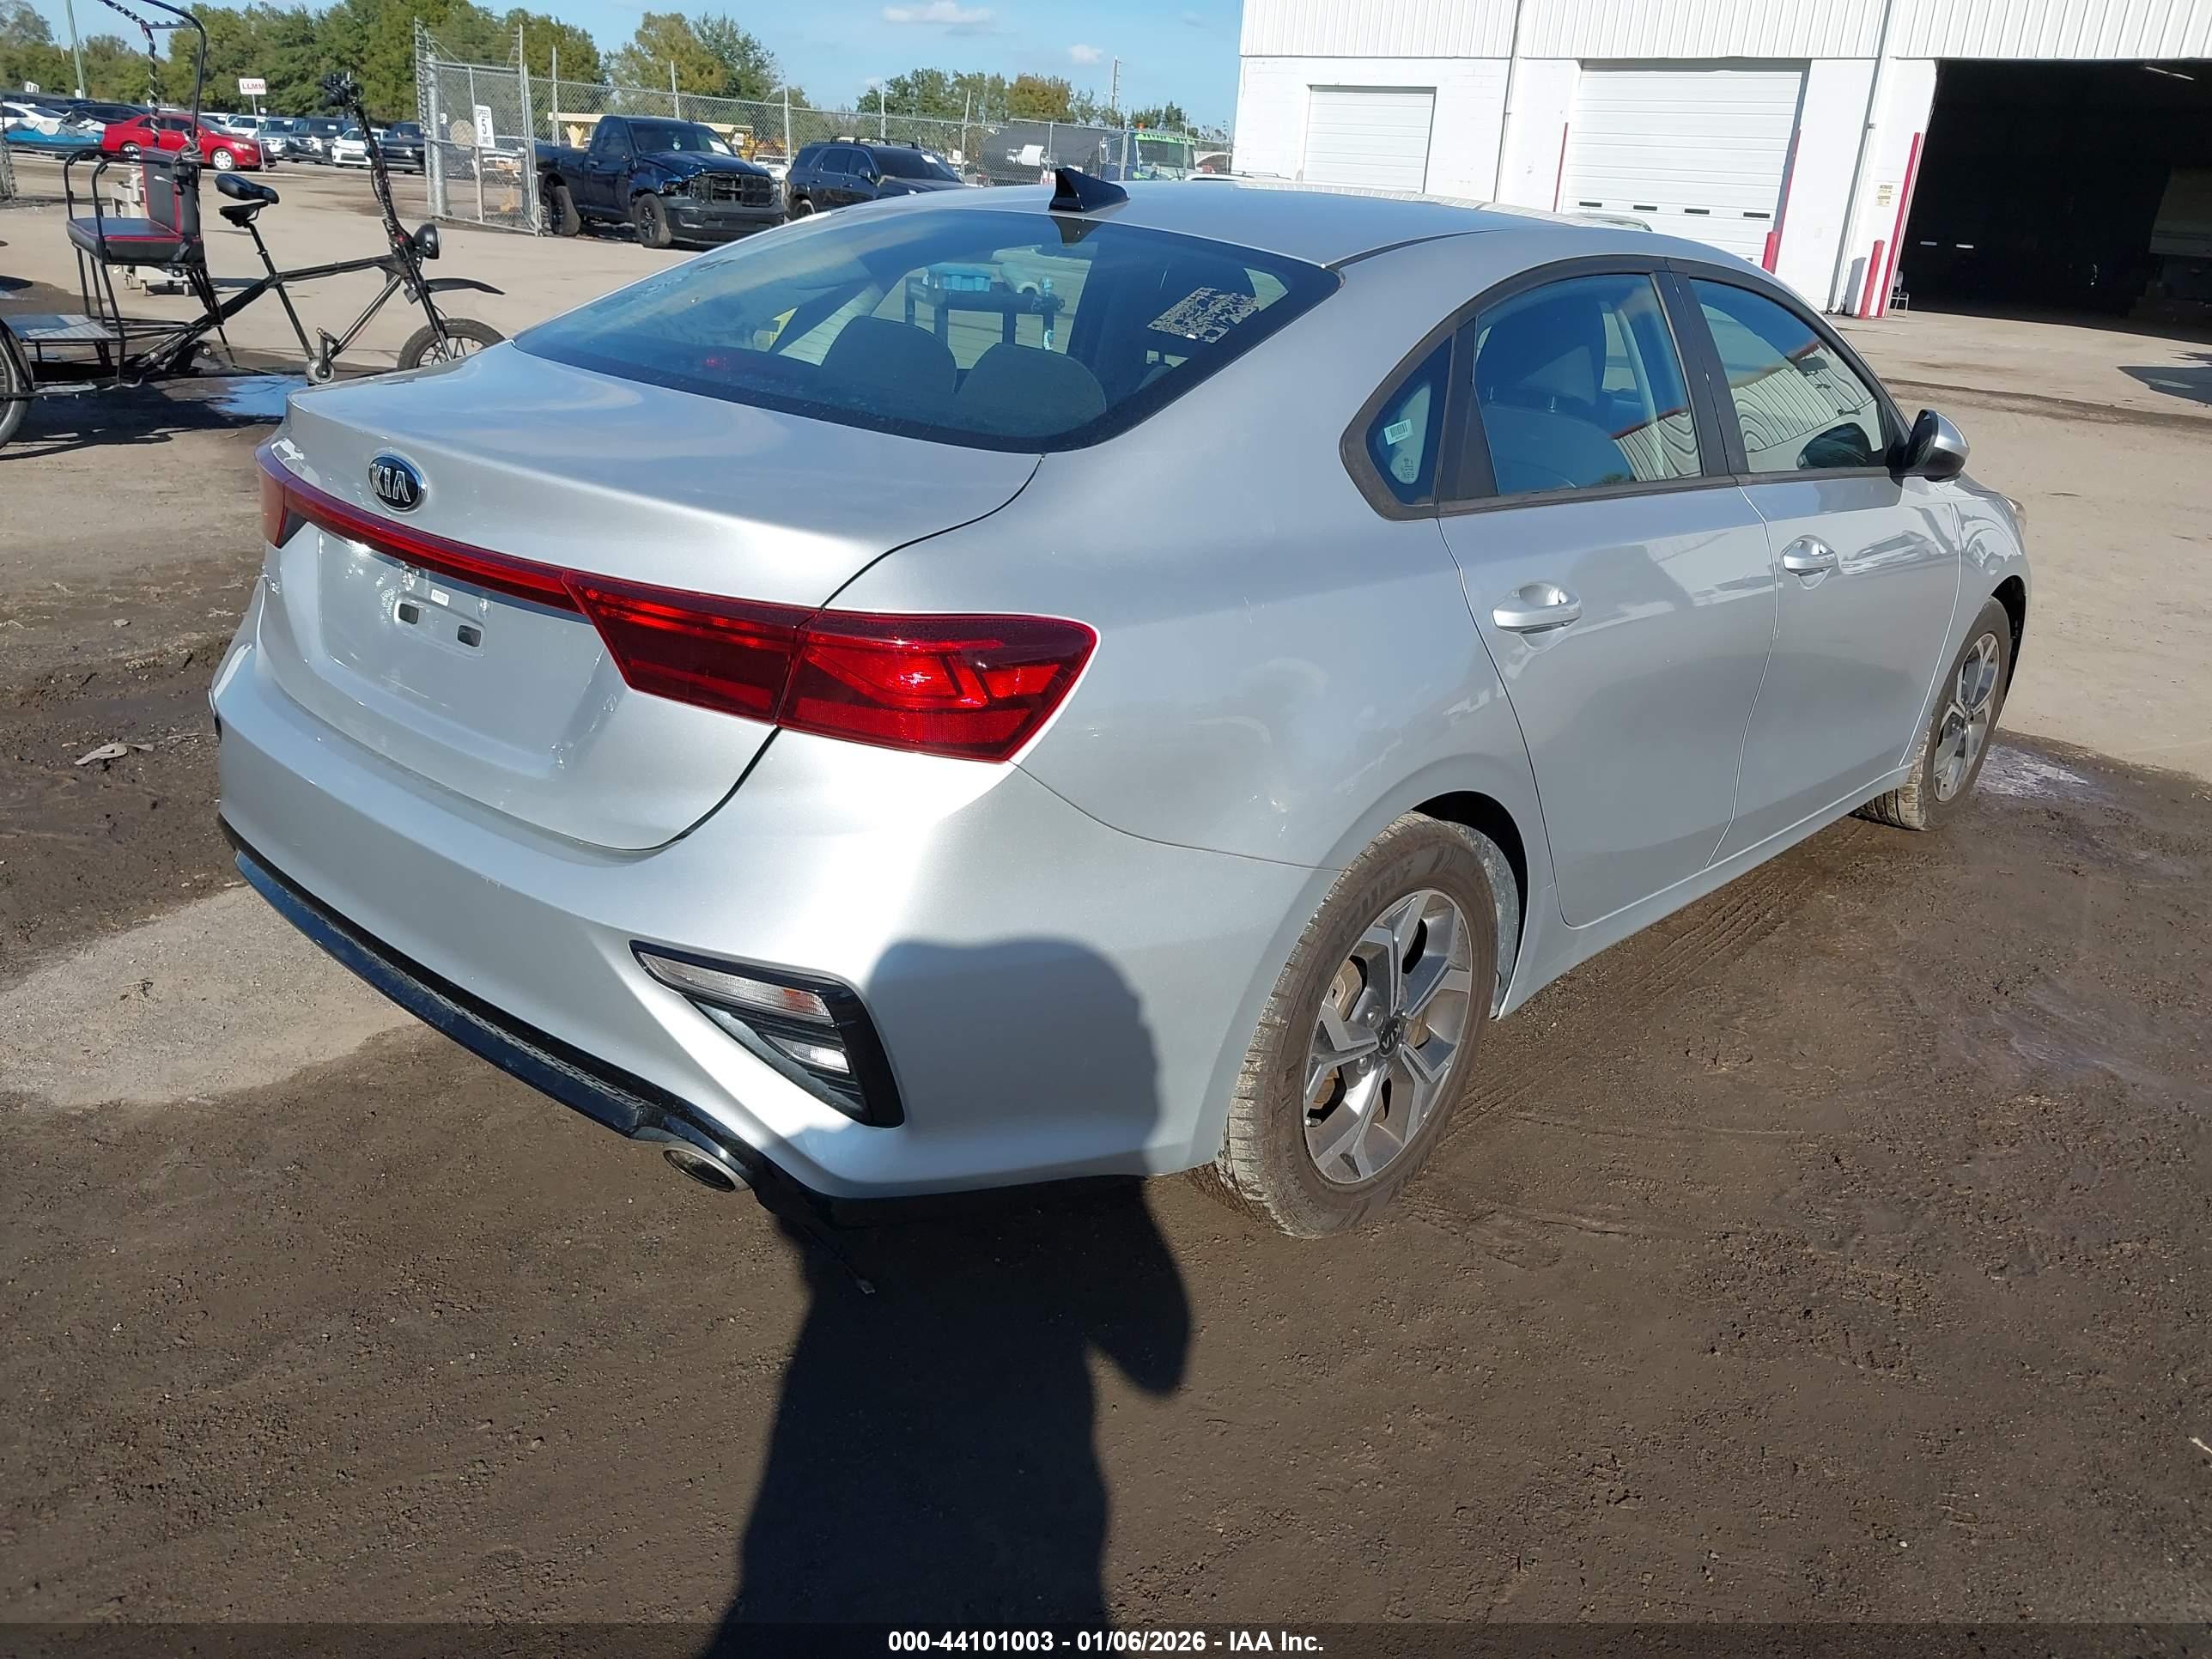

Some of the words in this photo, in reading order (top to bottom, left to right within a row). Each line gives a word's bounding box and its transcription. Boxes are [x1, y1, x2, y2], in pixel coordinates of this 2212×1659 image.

[482, 118, 488, 135] 5
[370, 463, 411, 502] KIA
[1382, 1023, 1402, 1049] KIA
